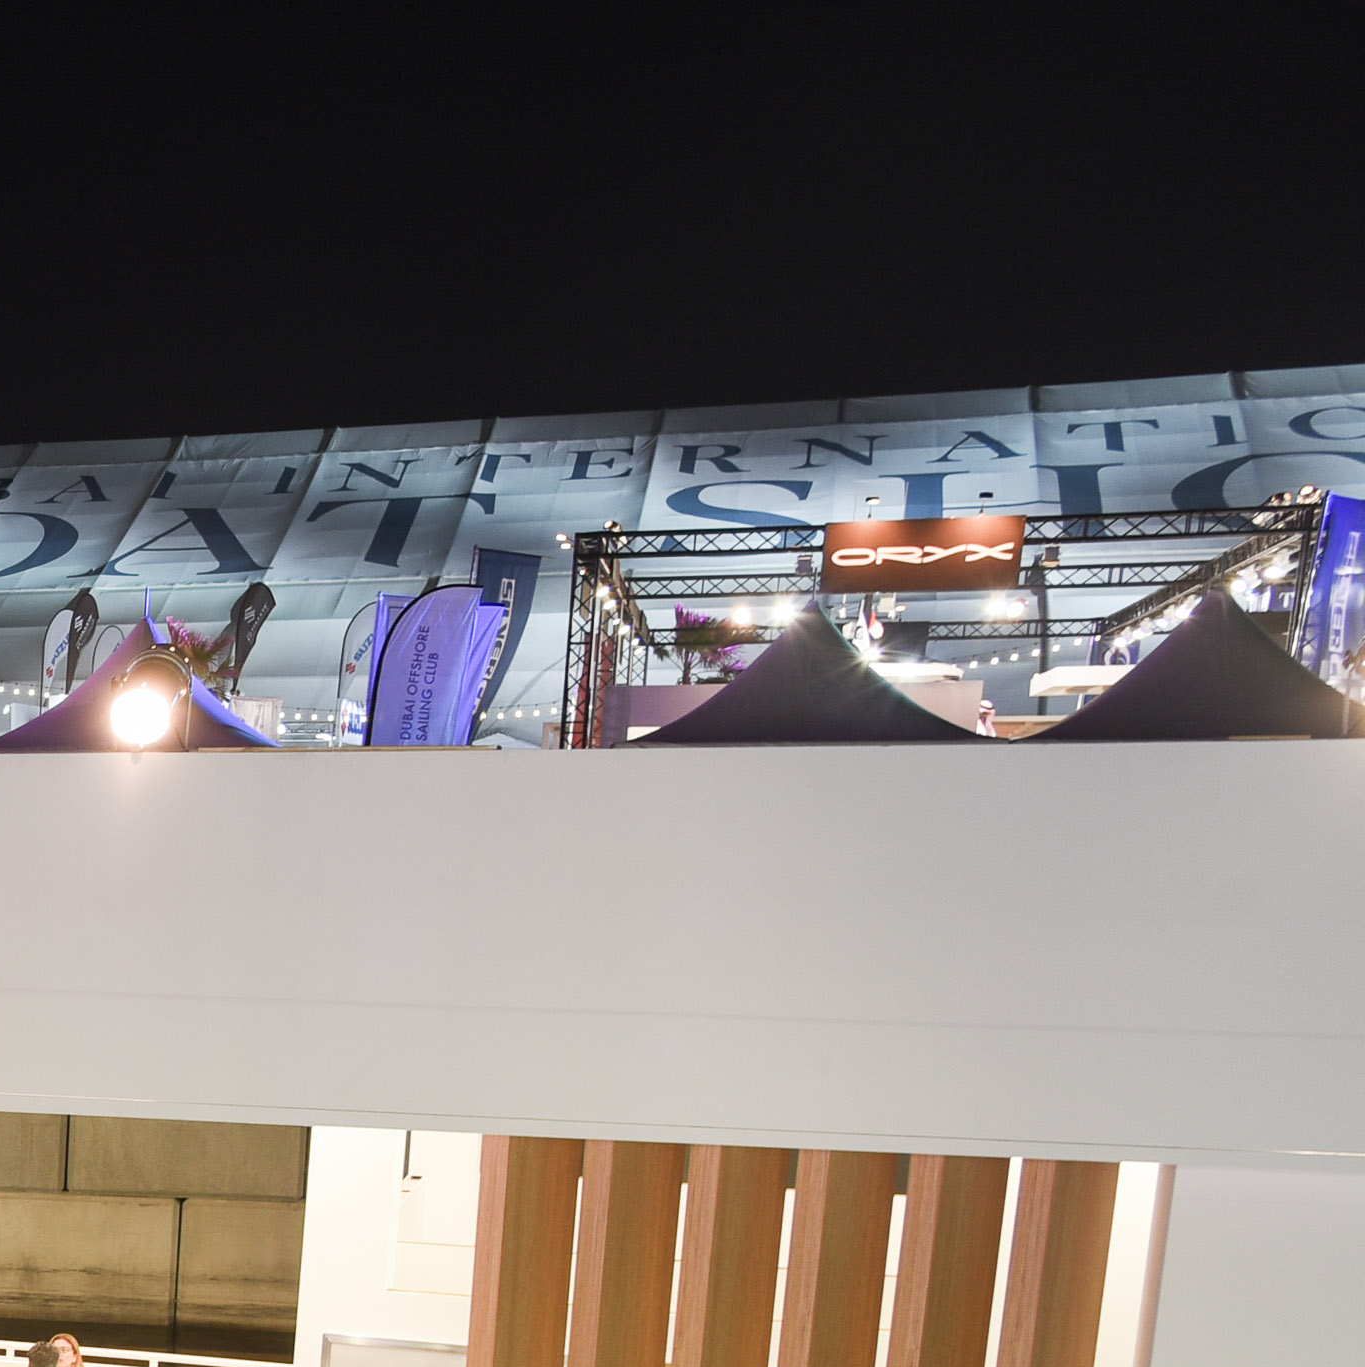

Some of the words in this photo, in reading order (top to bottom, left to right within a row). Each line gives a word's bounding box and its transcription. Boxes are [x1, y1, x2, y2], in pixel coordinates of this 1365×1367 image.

[831, 542, 1015, 567] ORYX
[407, 625, 430, 694] OFFSHORE
[424, 652, 439, 686] CLUB
[400, 699, 415, 741] DUBAI
[416, 689, 433, 741] SAILING
